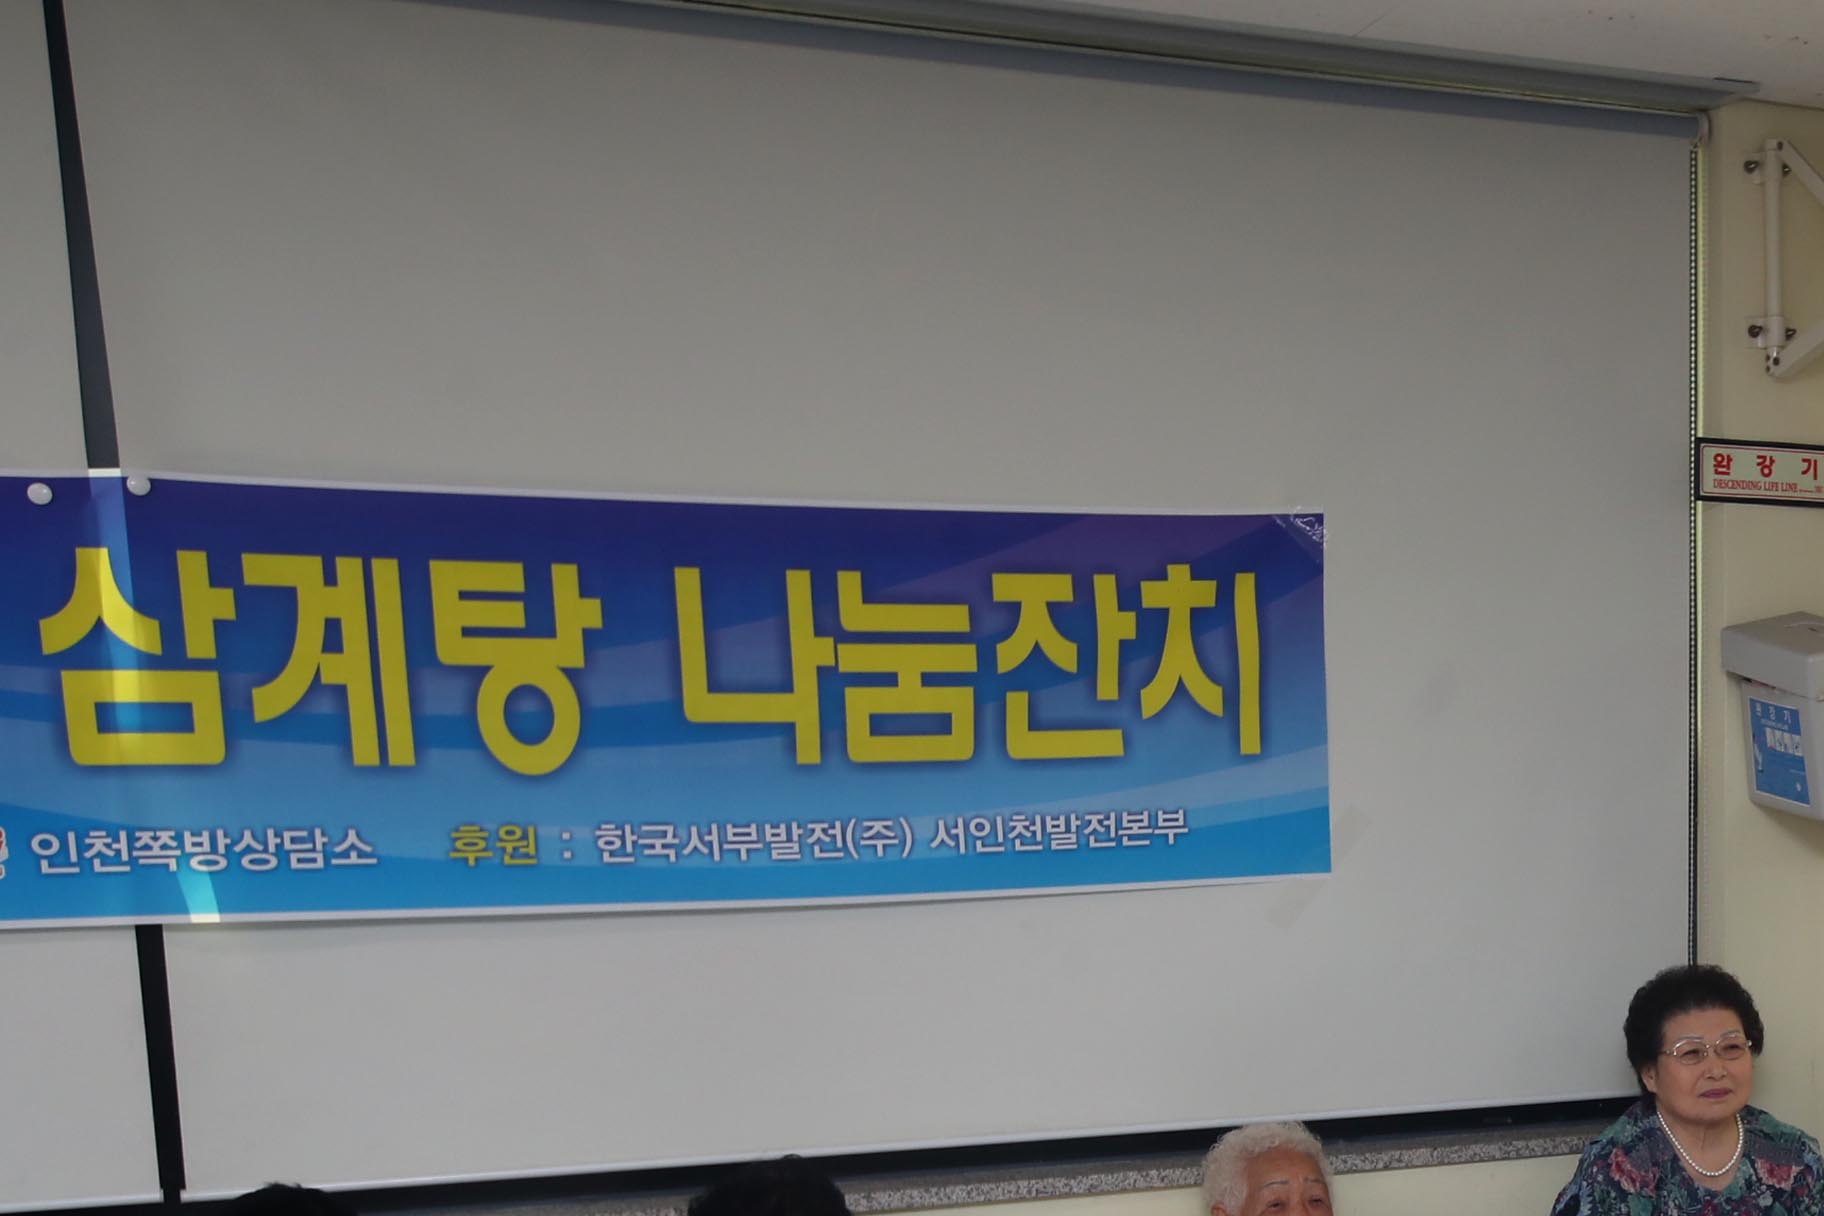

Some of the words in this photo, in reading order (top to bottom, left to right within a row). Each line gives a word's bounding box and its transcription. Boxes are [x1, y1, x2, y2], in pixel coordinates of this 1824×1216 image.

[1713, 453, 1733, 476] 완
[1756, 454, 1776, 478] 강
[1801, 457, 1818, 480] 기
[1713, 478, 1761, 490] DESCENDING
[1763, 481, 1780, 492] LIFE
[1781, 482, 1798, 493] LINE
[39, 546, 602, 776] 삼계탕
[674, 563, 1262, 765] 나눔잔치
[30, 826, 378, 876] 인천쪽방상담소
[449, 824, 538, 867] 후원
[594, 815, 914, 864] 한국서부발전(주)
[929, 807, 1189, 856] 서인천발전본부
